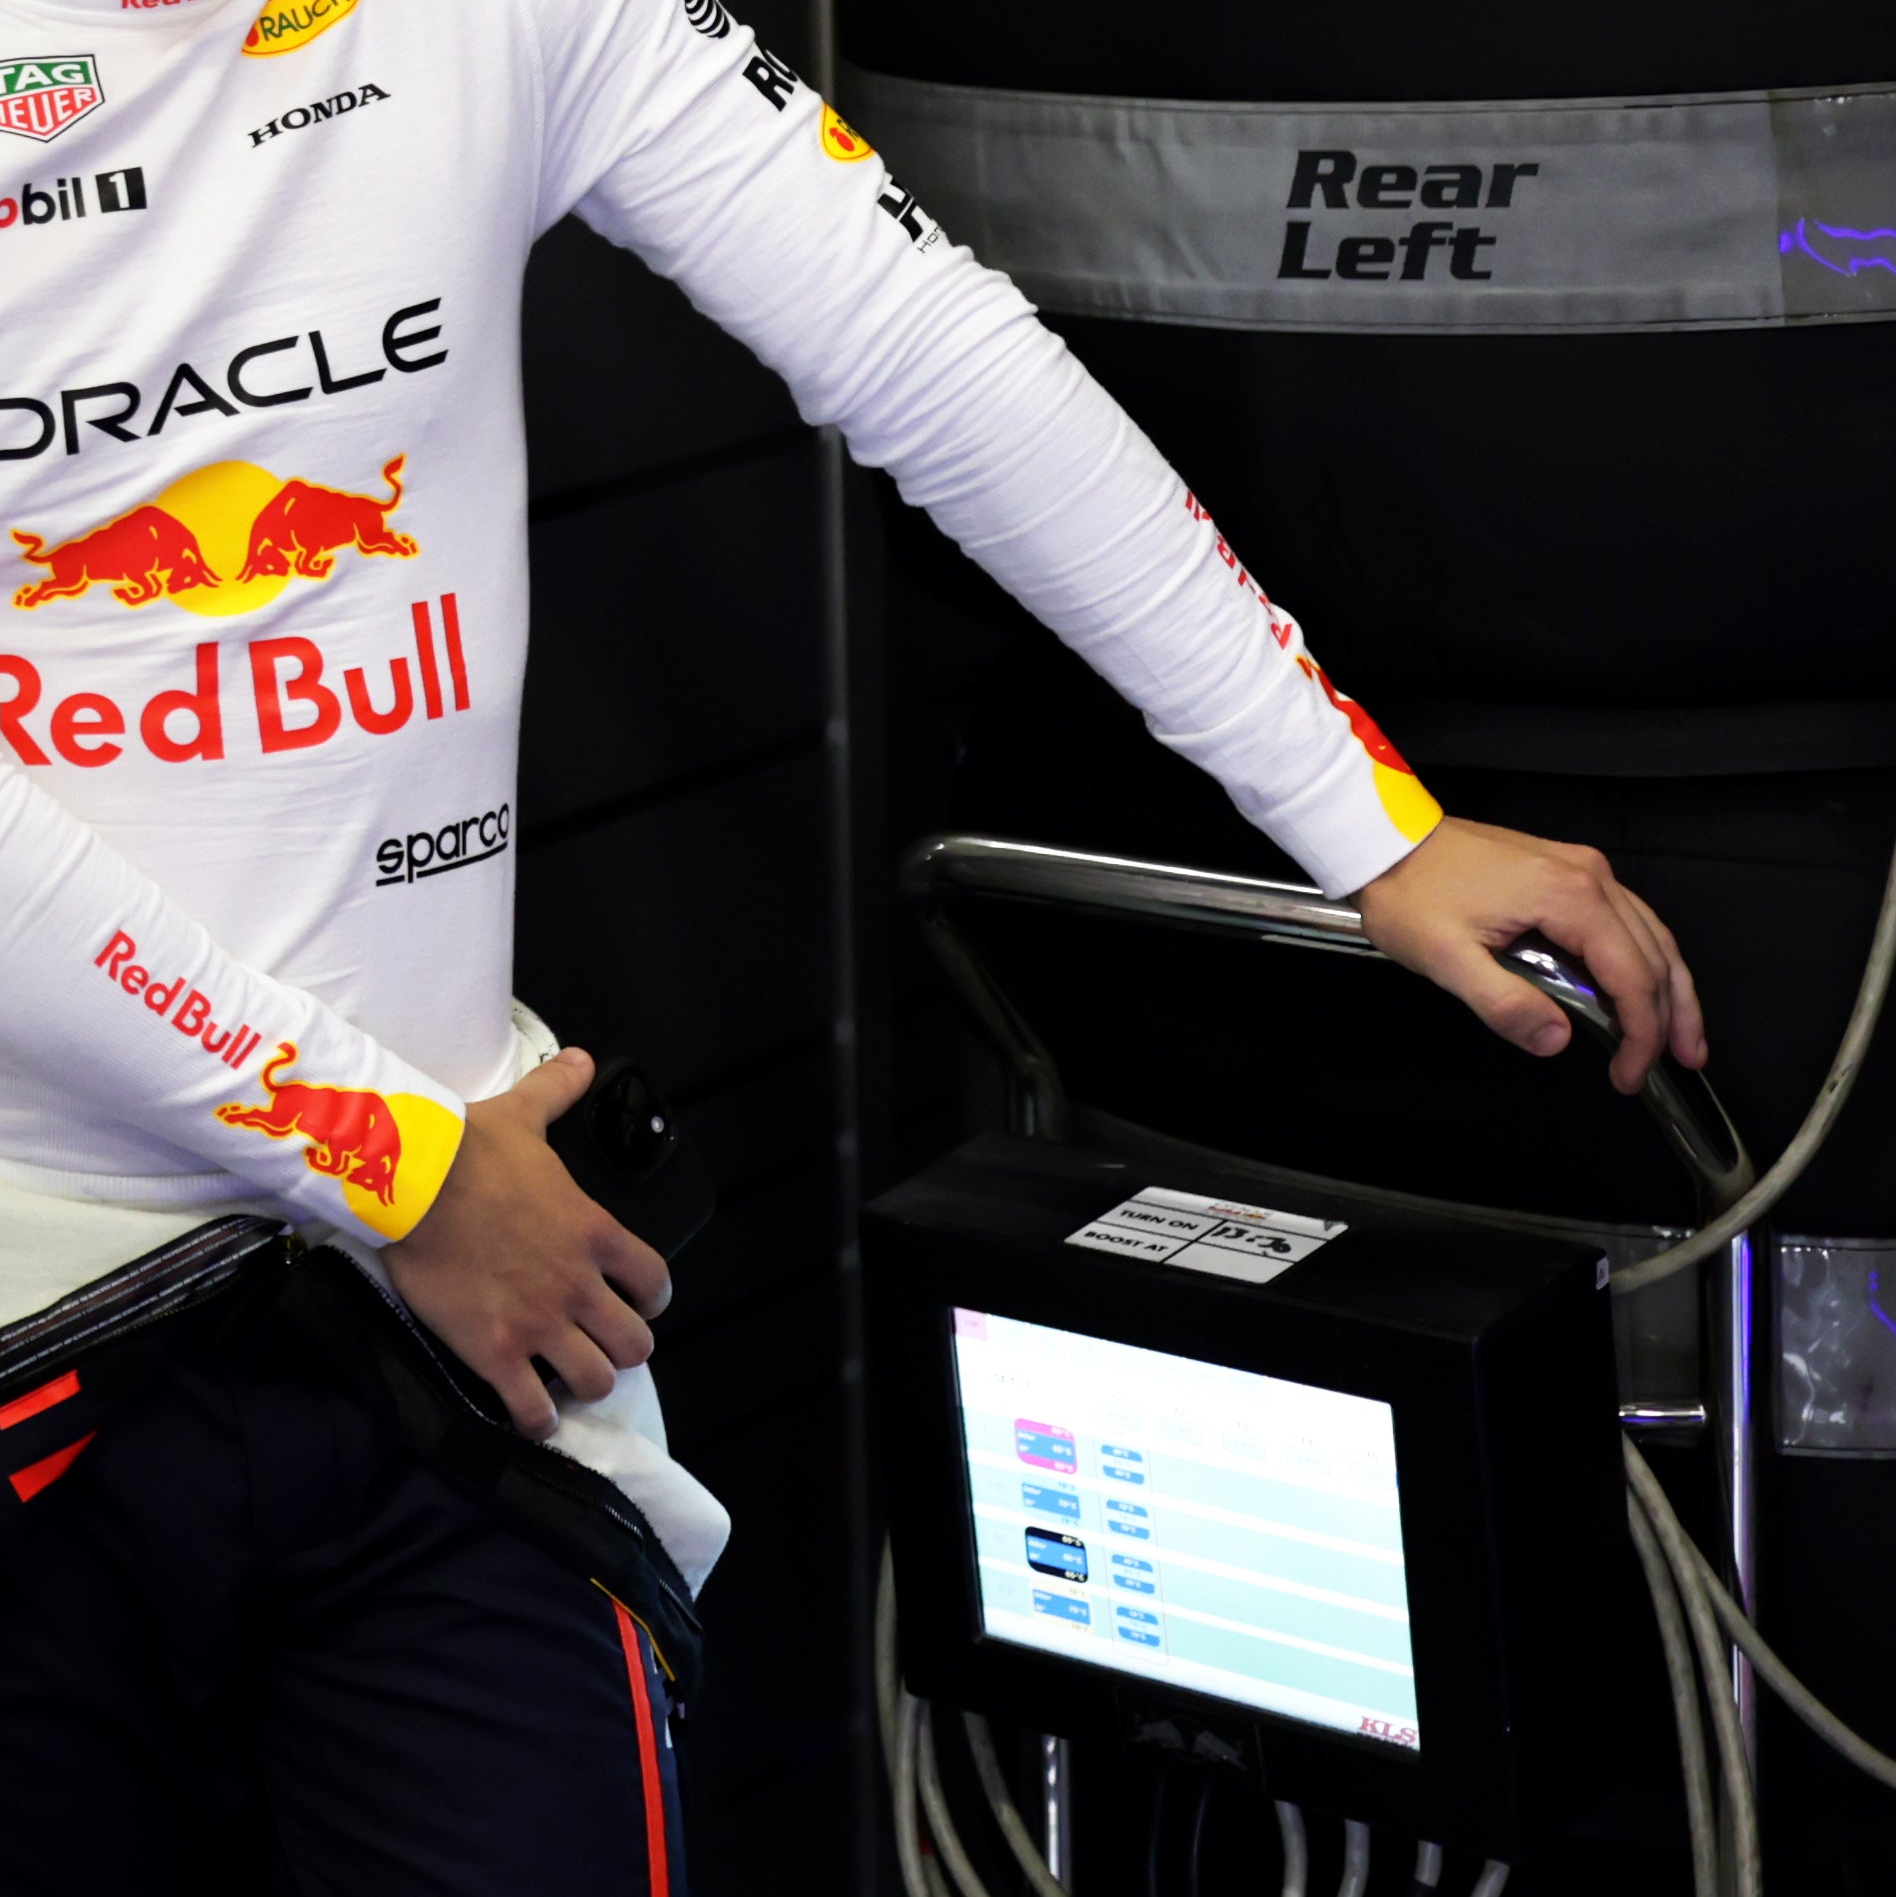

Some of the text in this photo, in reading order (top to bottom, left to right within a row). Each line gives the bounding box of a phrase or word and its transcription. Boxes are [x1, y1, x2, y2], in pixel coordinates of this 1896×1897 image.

[248, 82, 391, 148] HONDA
[1286, 149, 1539, 209] Rear
[1277, 220, 1497, 280] Left
[248, 592, 470, 754] Bull
[376, 803, 510, 885] sparco
[93, 929, 263, 1070] Red Bull
[1084, 1230, 1169, 1253] BOOST AT
[1118, 1209, 1200, 1231] TURN ON
[1358, 1716, 1417, 1743] KLS
